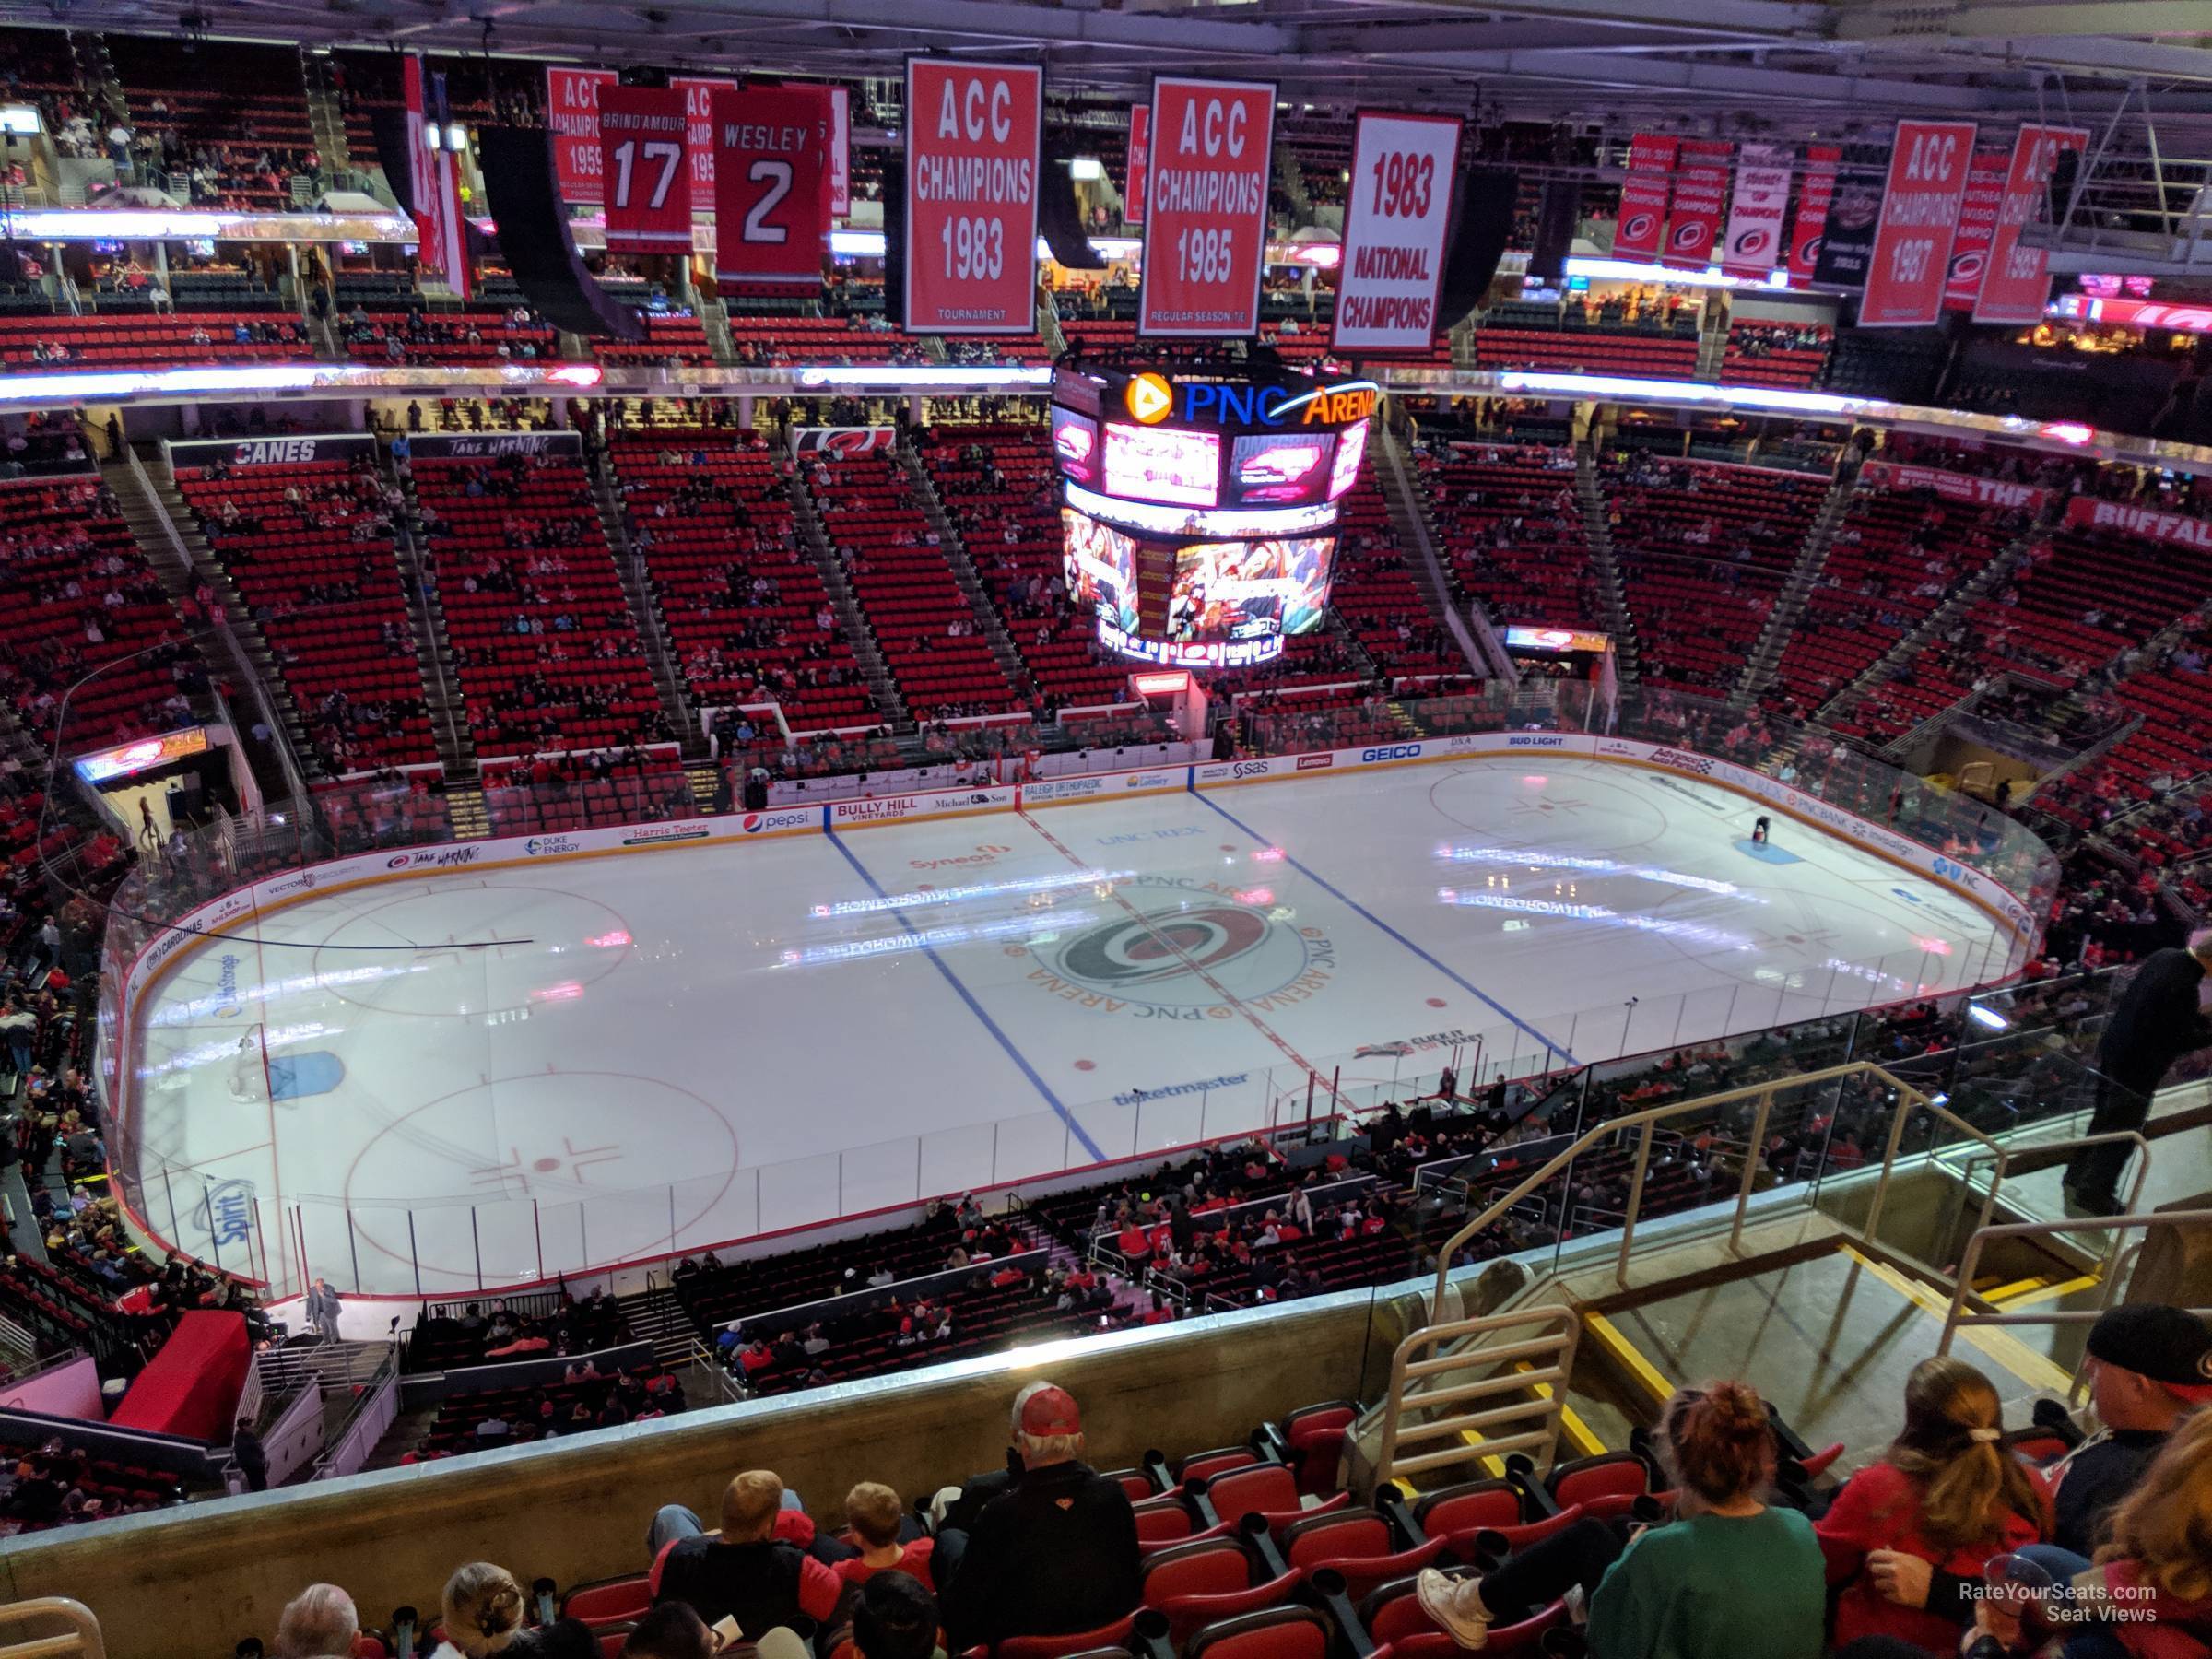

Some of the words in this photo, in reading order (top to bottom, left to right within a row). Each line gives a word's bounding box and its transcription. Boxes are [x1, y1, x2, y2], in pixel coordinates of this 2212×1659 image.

[687, 87, 711, 117] AC
[938, 78, 1011, 143] ACC
[603, 112, 685, 132] BRIND'AMOUR
[1179, 98, 1247, 159] ACC
[723, 124, 807, 151] WESLEY
[691, 153, 715, 182] 195
[1905, 134, 1956, 182] ACC
[615, 140, 682, 208] 17
[917, 154, 1030, 204] CHAMPIONS
[1372, 151, 1435, 218] 1983
[743, 159, 793, 242] 2
[1157, 168, 1260, 215] CHAMPIONS
[1888, 192, 1960, 227] CHAMPIONS
[943, 215, 1003, 280] 1983
[1178, 228, 1233, 283] 1985
[1354, 245, 1429, 280] NATIONAL
[1892, 239, 1934, 283] 1987
[937, 308, 1006, 321] TOURNAMENT
[1151, 311, 1193, 322] REGULAR
[1194, 311, 1230, 323] SEASON
[1342, 295, 1431, 330] CHAMPIONS
[1185, 383, 1290, 426] PNC
[1302, 385, 1376, 426] ARENA
[235, 441, 316, 465] CANES
[449, 440, 483, 456] TAKE
[488, 435, 549, 456] WARNING
[2093, 502, 2212, 547] BUFFAL
[1509, 736, 1531, 745] BUD
[1533, 736, 1564, 746] LIGHT
[1299, 756, 1331, 768] Lenovo
[1362, 745, 1421, 762] GEICO
[1244, 761, 1269, 774] sas
[1024, 783, 1053, 795] RALEIGH
[838, 803, 885, 817] BULLY
[887, 798, 918, 811] HILL
[935, 796, 970, 809] Michael
[991, 794, 1007, 803] Son
[766, 811, 809, 829] pepsi
[852, 809, 905, 821] VINEYARDS
[543, 835, 568, 846] DUKE
[633, 828, 670, 838] Harris
[673, 824, 709, 834] Teeter
[1095, 831, 1150, 846] UNC
[414, 850, 436, 865] TAKE
[437, 845, 481, 867] WARNING
[544, 843, 580, 854] ENERGY
[910, 853, 996, 870] Syneos
[268, 879, 303, 894] VECTOR
[1135, 875, 1195, 888] PNC
[1963, 874, 1980, 890] NC
[161, 919, 203, 955] CAROLINAS
[1307, 938, 1335, 968] PNC
[1027, 968, 1129, 1013] ARENA
[1248, 968, 1332, 1012] ARENA
[1133, 1005, 1206, 1021] PNC
[1411, 1031, 1449, 1045] CLICK
[1451, 1030, 1464, 1038] IT
[1418, 1042, 1439, 1051] OR
[1440, 1033, 1485, 1047] TICKET
[1112, 1072, 1250, 1108] ticketmaster
